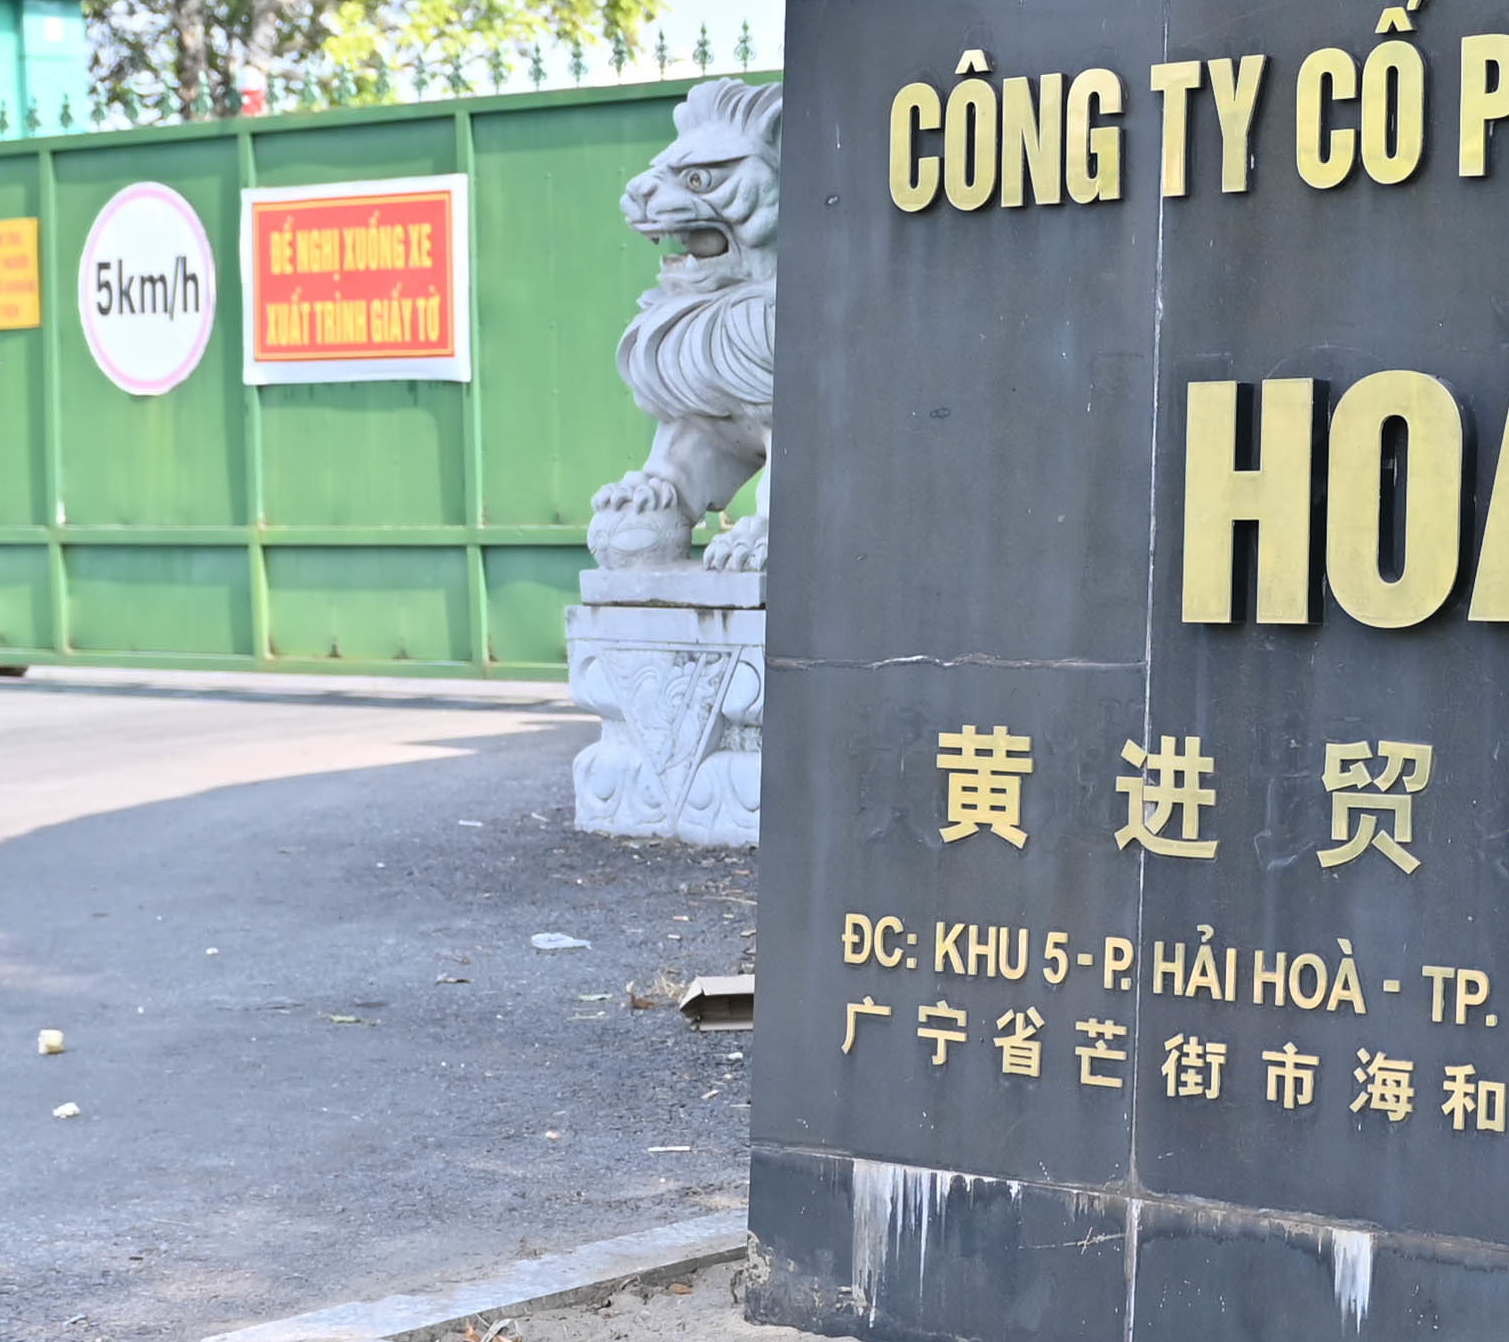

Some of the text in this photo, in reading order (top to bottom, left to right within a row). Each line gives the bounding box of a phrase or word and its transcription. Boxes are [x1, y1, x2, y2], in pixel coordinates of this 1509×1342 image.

[888, 47, 1127, 213] CÔNG
[1150, 53, 1268, 198] TY
[296, 227, 340, 282] NGHỊ
[343, 210, 406, 272] XUỐNG
[408, 222, 433, 269] XE
[95, 256, 200, 321] 5km/h
[265, 281, 441, 346] XUẤT TRÌNH GIẤY TỜ
[841, 912, 919, 970] ĐC:
[933, 921, 1029, 981] KHU
[1152, 923, 1237, 1002] HẢI
[1253, 939, 1366, 1015] HOÀ
[1422, 965, 1498, 1028] TP.
